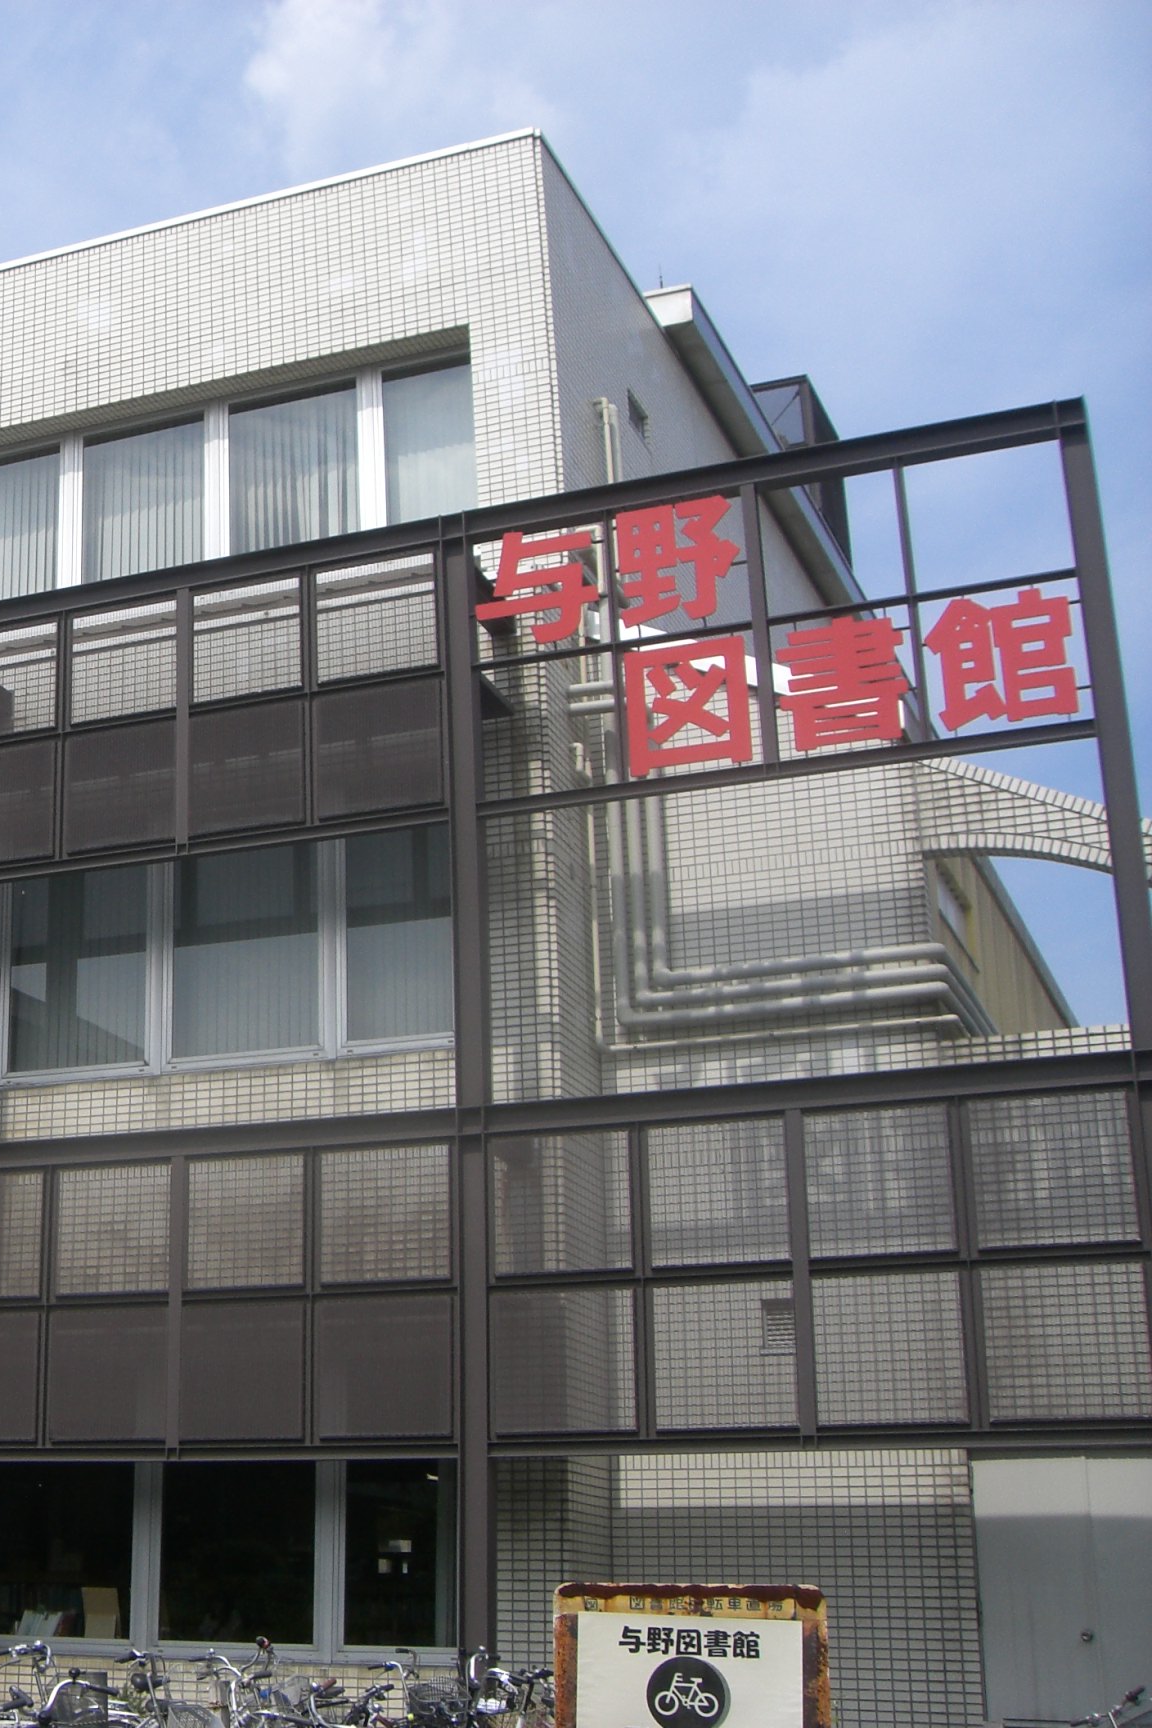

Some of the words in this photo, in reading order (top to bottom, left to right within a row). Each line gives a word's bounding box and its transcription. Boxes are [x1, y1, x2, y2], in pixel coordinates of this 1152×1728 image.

[476, 495, 739, 643] 与野
[624, 588, 1078, 777] 図書館
[618, 1626, 760, 1659] 与野図書館
